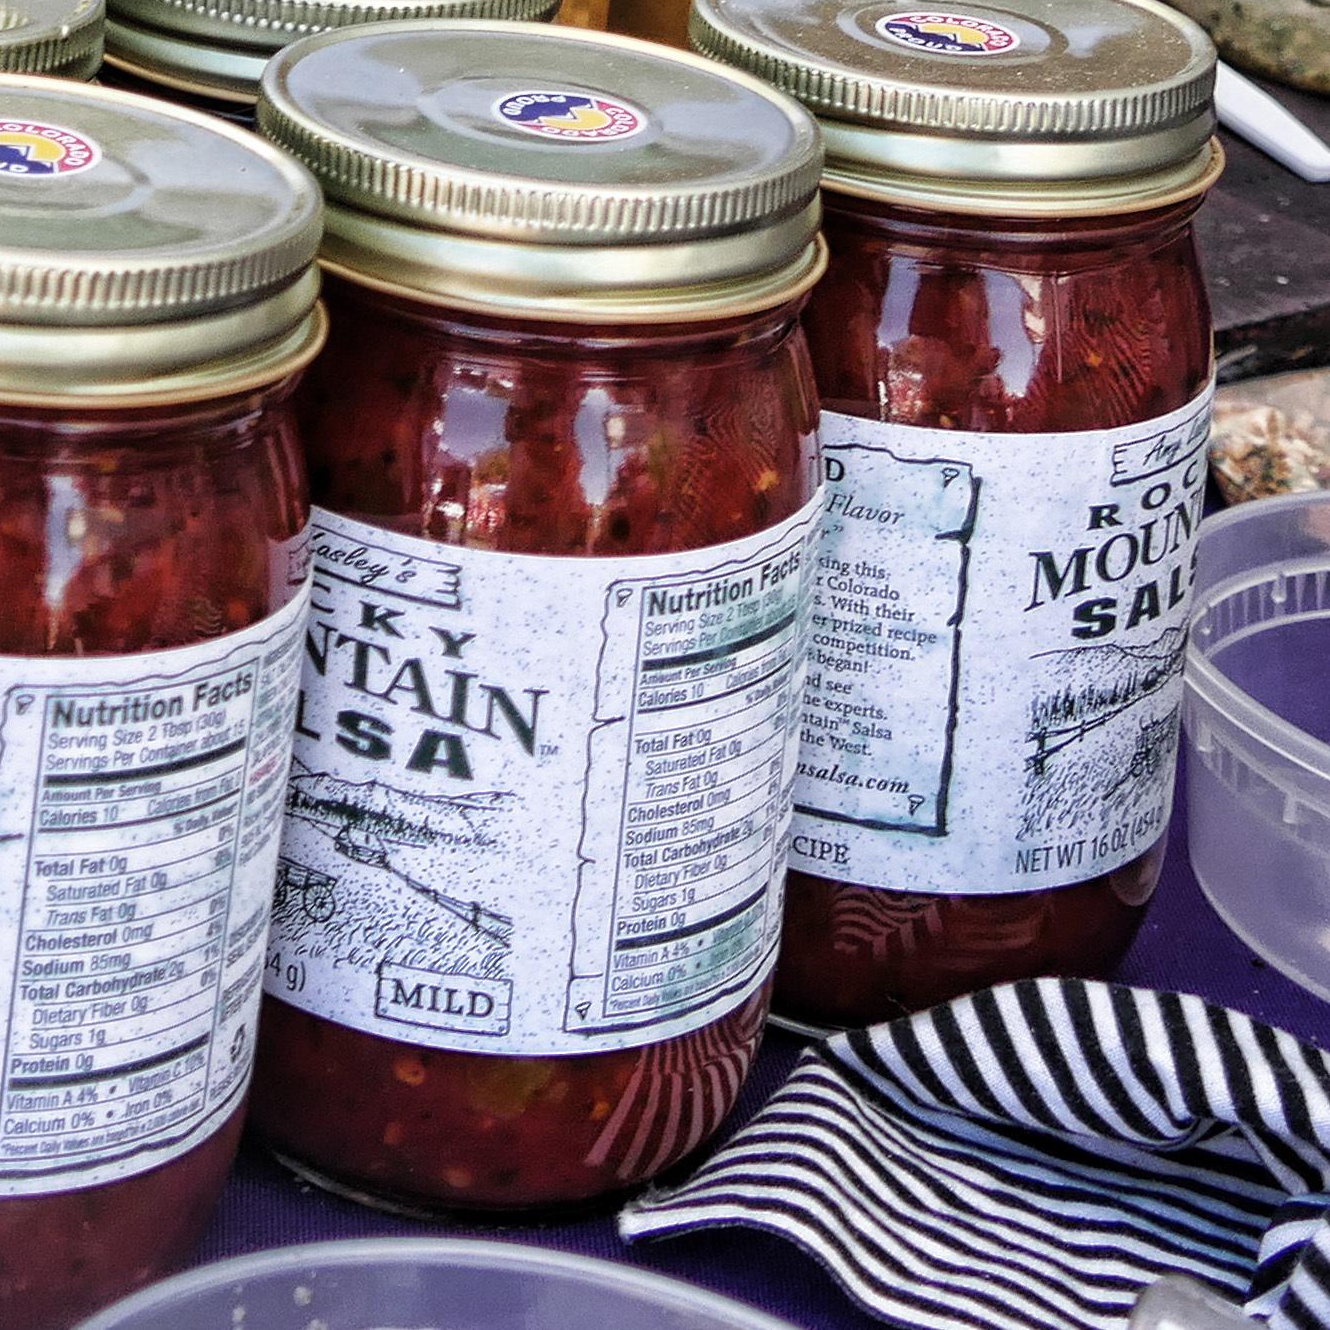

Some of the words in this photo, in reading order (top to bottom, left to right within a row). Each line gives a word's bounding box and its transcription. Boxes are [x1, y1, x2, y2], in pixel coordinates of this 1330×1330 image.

[889, 28, 962, 51] PROUD
[909, 16, 1009, 47] COLORADO
[503, 95, 567, 116] PROUD
[541, 107, 634, 137] COLORADO
[1087, 459, 1198, 531] ROC
[826, 494, 905, 525] Flavor
[647, 577, 753, 617] Nutrition
[760, 552, 801, 591] Facts
[827, 575, 900, 601] Colorado
[1071, 550, 1197, 640] SAL
[831, 595, 870, 616] With
[874, 604, 915, 622] their
[831, 619, 882, 637] prized
[887, 625, 937, 647] recipe
[812, 634, 916, 661] competition.
[51, 695, 184, 728] Nutrition
[192, 672, 252, 712] Facts
[306, 622, 550, 758] NTAIN
[826, 679, 853, 695] see
[824, 700, 889, 721] experts.
[47, 732, 108, 751] Serving
[113, 729, 141, 745] Size
[162, 719, 192, 738] Tbsp
[295, 691, 474, 780] LSA
[799, 730, 825, 746] the
[829, 736, 873, 756] West.
[851, 723, 893, 740] Salsa
[45, 753, 109, 771] Servings
[113, 750, 134, 766] Per
[140, 738, 198, 762] Container
[634, 736, 668, 755] Total
[796, 760, 910, 794] nsalsa.com
[42, 786, 92, 802] Amount
[95, 785, 115, 799] Per
[118, 780, 163, 798] Serving
[40, 808, 97, 826] Calories
[103, 805, 119, 820] 10
[628, 795, 704, 823] Cholesterol
[625, 827, 678, 846] Sodium
[1015, 846, 1054, 874] NET
[1057, 839, 1086, 869] WT
[1091, 833, 1109, 860] 16
[1112, 823, 1129, 852] OZ
[793, 836, 851, 865] CIPE
[34, 860, 74, 878] Total
[78, 858, 106, 875] Fat
[109, 855, 128, 876] 0g
[46, 880, 120, 902] Saturated
[124, 874, 147, 891] Fat
[46, 909, 86, 926] Trans
[91, 905, 114, 921] Fat
[25, 929, 117, 951] Cholesterol
[122, 923, 154, 942] 0mg
[21, 959, 84, 977] Sodium
[90, 953, 132, 973] 85mg
[19, 984, 60, 1001] Total
[65, 967, 165, 999] Carbohydrate
[32, 1005, 88, 1026] Dietary
[91, 999, 127, 1017] Fiber
[390, 979, 495, 1019] MILD
[29, 1033, 82, 1051] Sugars
[10, 1058, 70, 1075] Protein
[6, 1092, 59, 1111] Vitamin
[3, 1118, 65, 1135] Calcium
[70, 1112, 96, 1130] 0%
